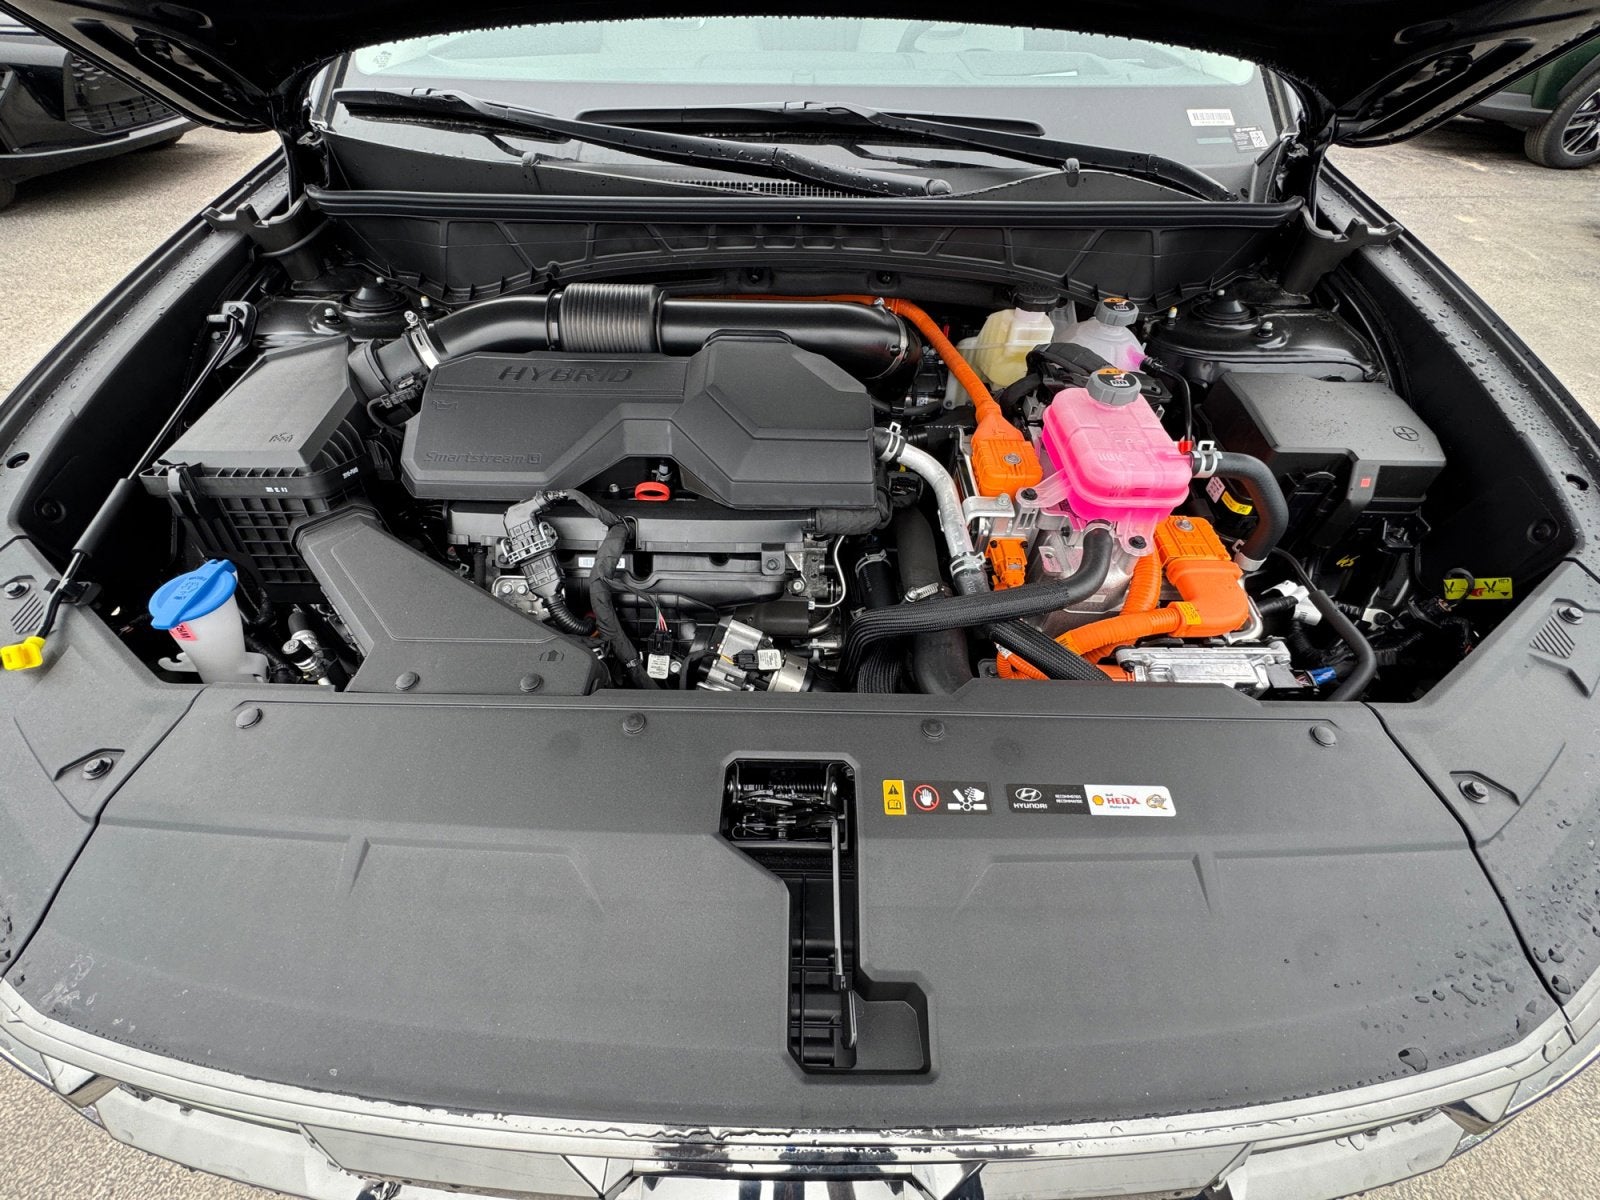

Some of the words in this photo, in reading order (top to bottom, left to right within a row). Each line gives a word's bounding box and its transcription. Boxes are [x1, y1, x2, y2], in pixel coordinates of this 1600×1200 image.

[498, 366, 633, 383] HYBRID
[426, 451, 525, 464] Smartstream
[1106, 797, 1140, 805] HELIX
